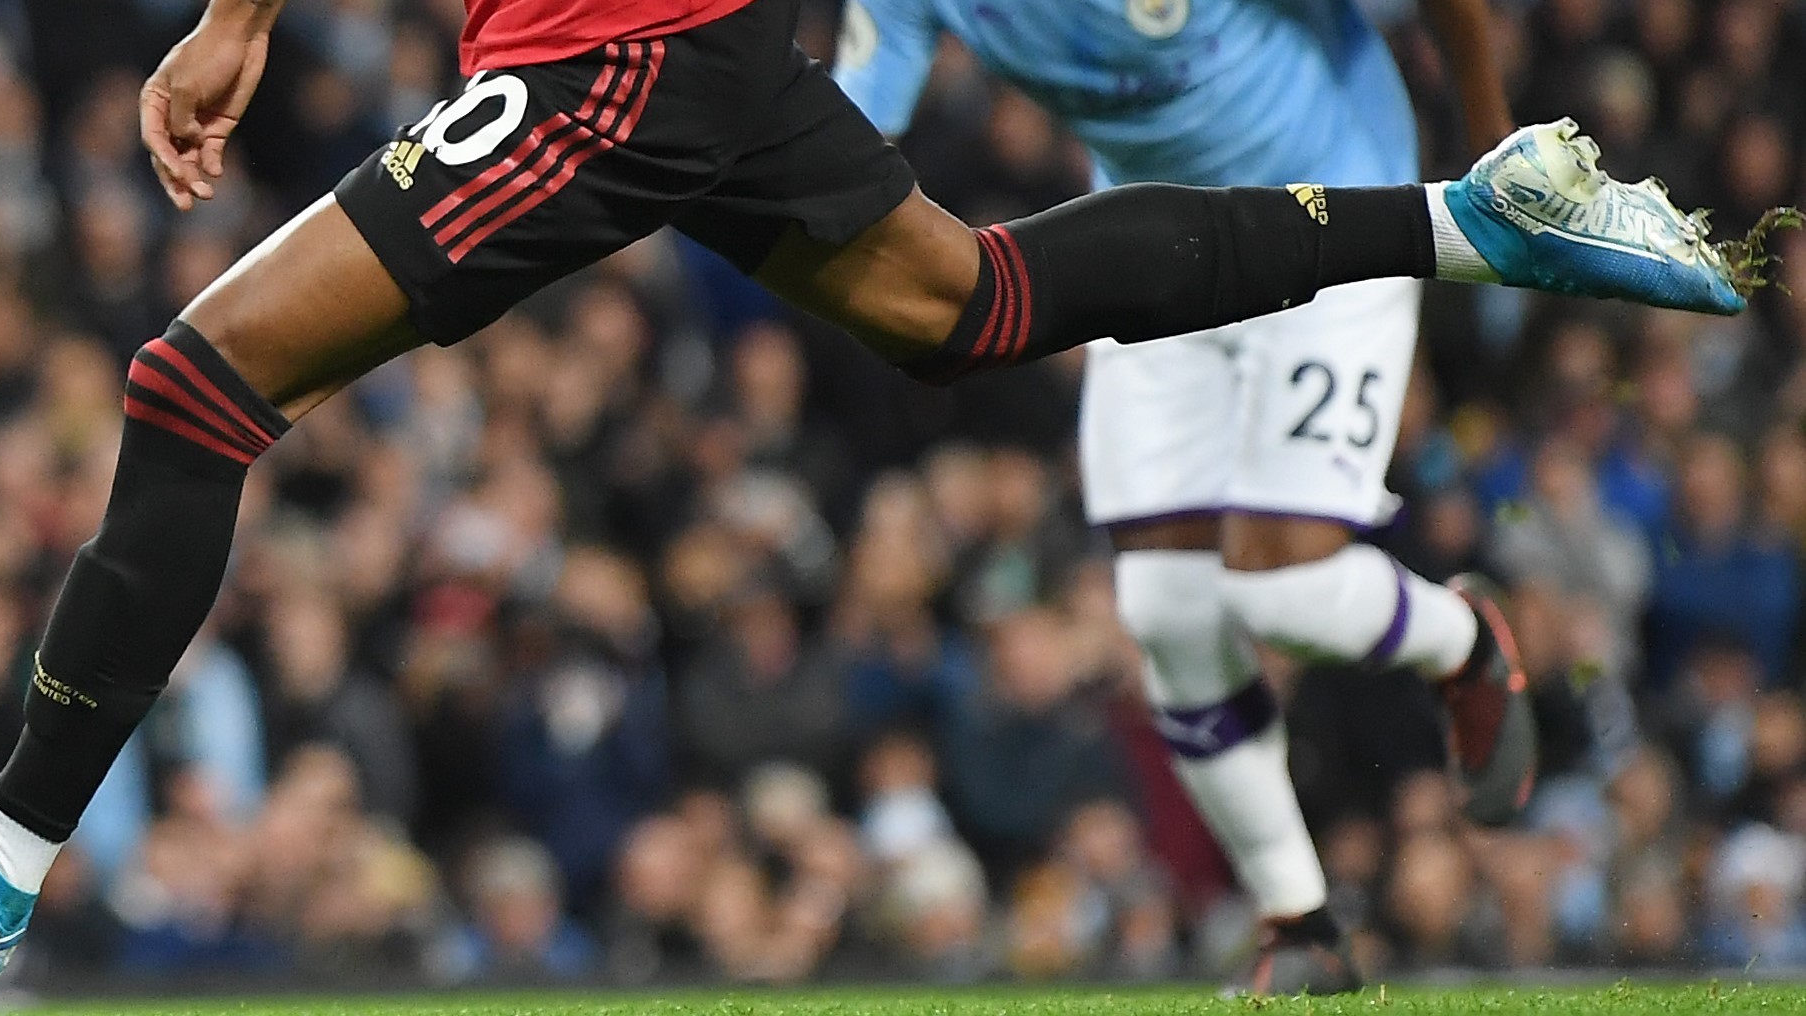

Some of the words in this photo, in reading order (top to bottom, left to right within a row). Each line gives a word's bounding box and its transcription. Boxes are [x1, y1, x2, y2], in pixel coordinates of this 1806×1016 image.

[381, 150, 413, 191] didas
[1312, 183, 1329, 225] adid
[1289, 361, 1379, 448] 25
